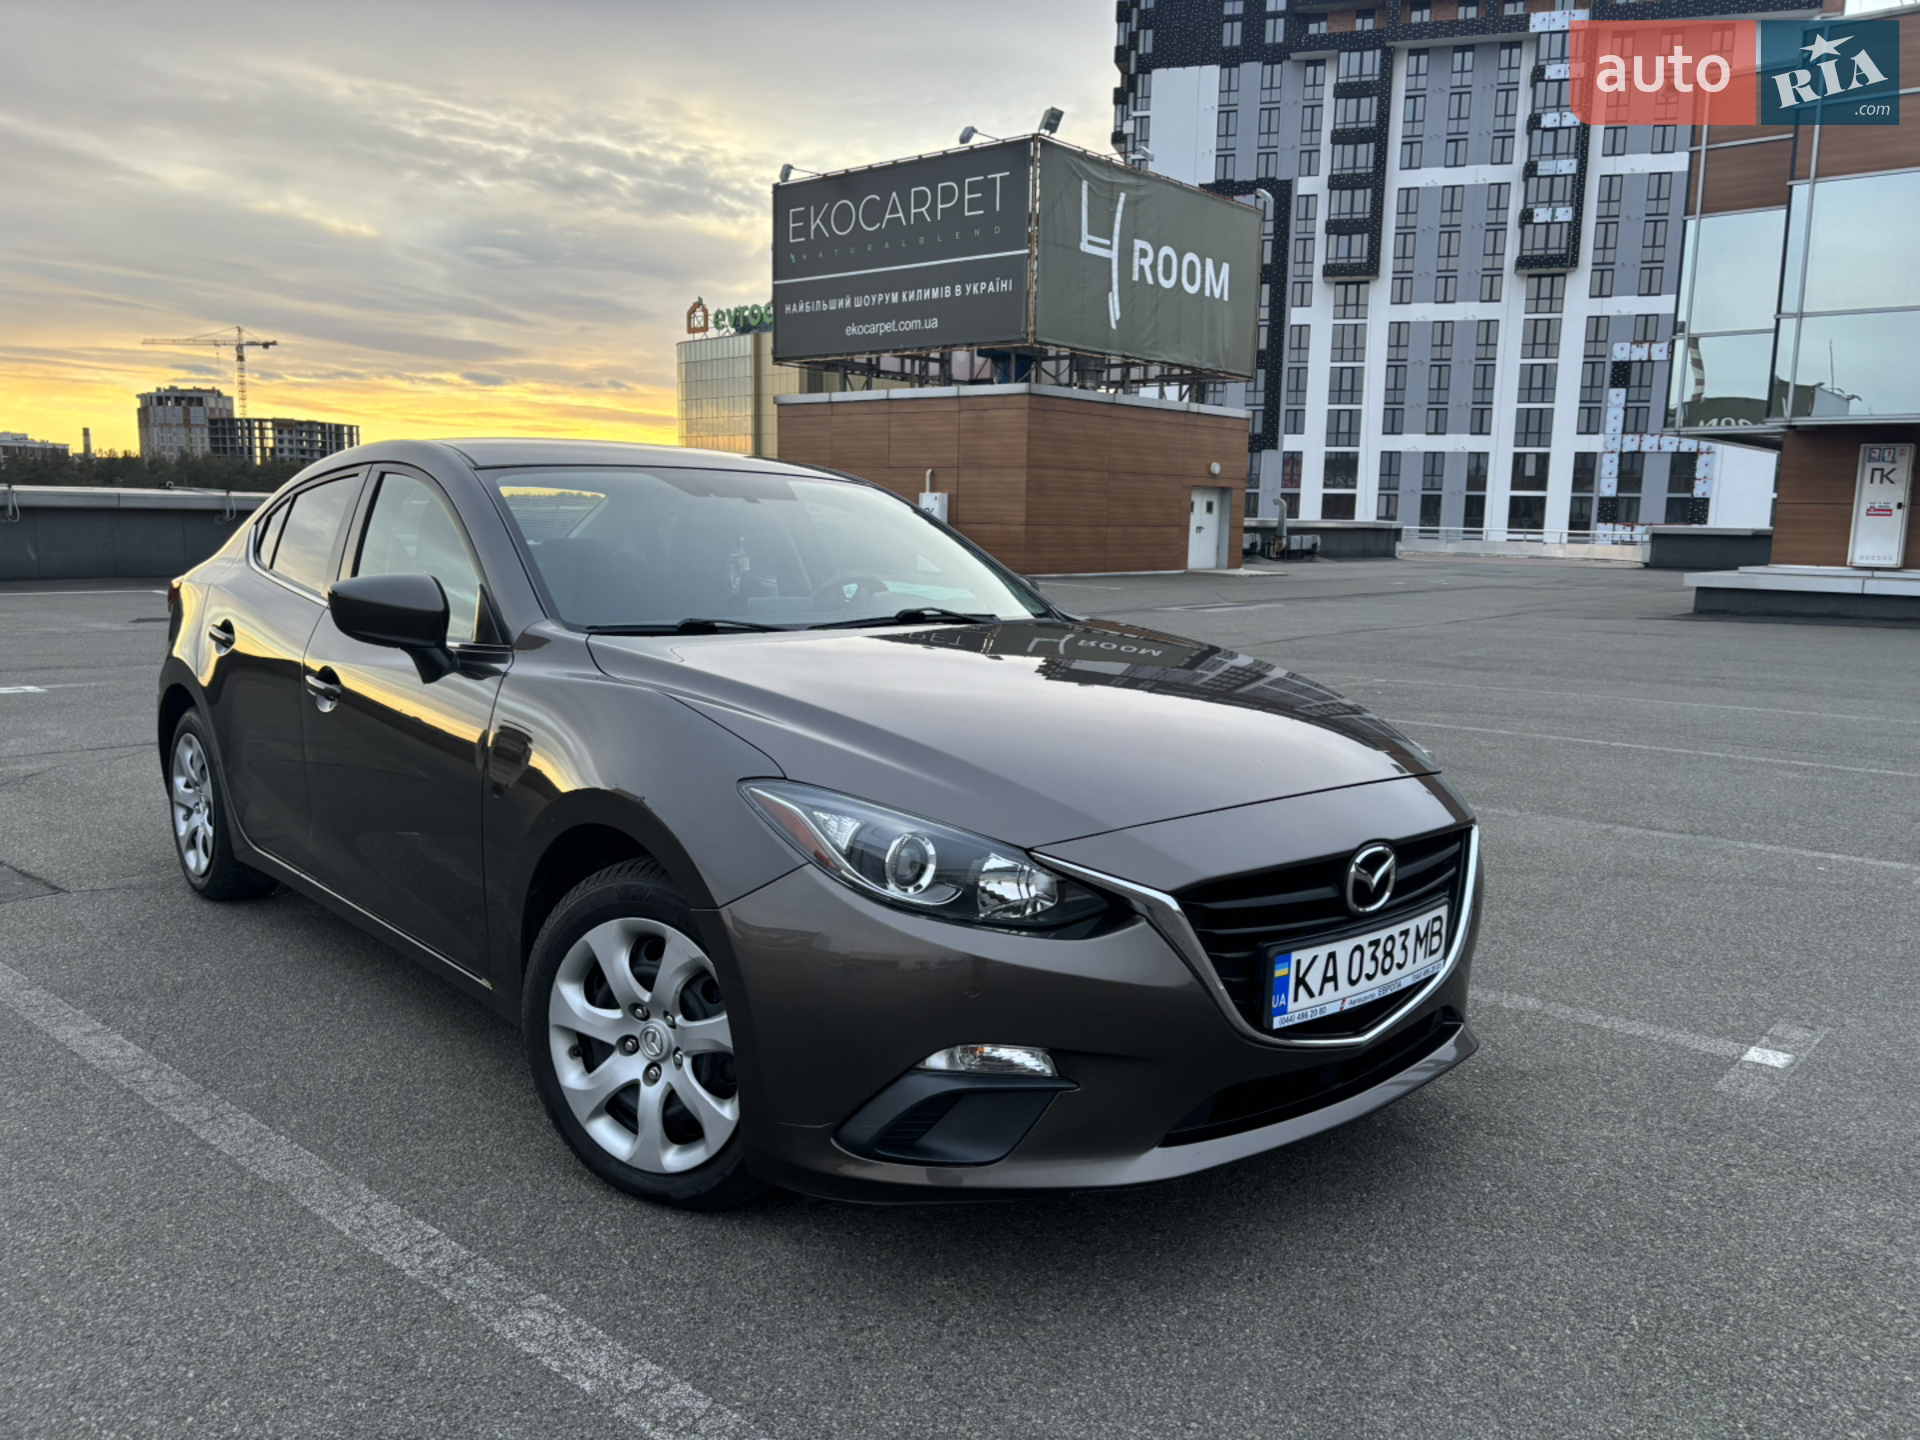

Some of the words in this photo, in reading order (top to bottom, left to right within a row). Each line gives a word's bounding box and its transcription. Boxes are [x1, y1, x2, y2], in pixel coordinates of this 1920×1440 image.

[788, 171, 1010, 244] EKOCARPET
[1131, 238, 1230, 303] ROOM
[785, 294, 851, 315] НАЙБІЛЬШИЙ
[854, 291, 899, 309] ШОУРУМ
[902, 285, 951, 303] КИЛИМІВ
[955, 284, 962, 297] В
[965, 277, 1013, 296] УКРАЇНІ
[845, 316, 939, 337] ekocarpet.com.ua
[1869, 467, 1897, 485] ПК
[1293, 953, 1339, 1003] KA
[1347, 928, 1411, 987] 0383
[1412, 915, 1443, 965] MB
[1272, 993, 1287, 1009] UA
[1278, 1013, 1296, 1026] (044)
